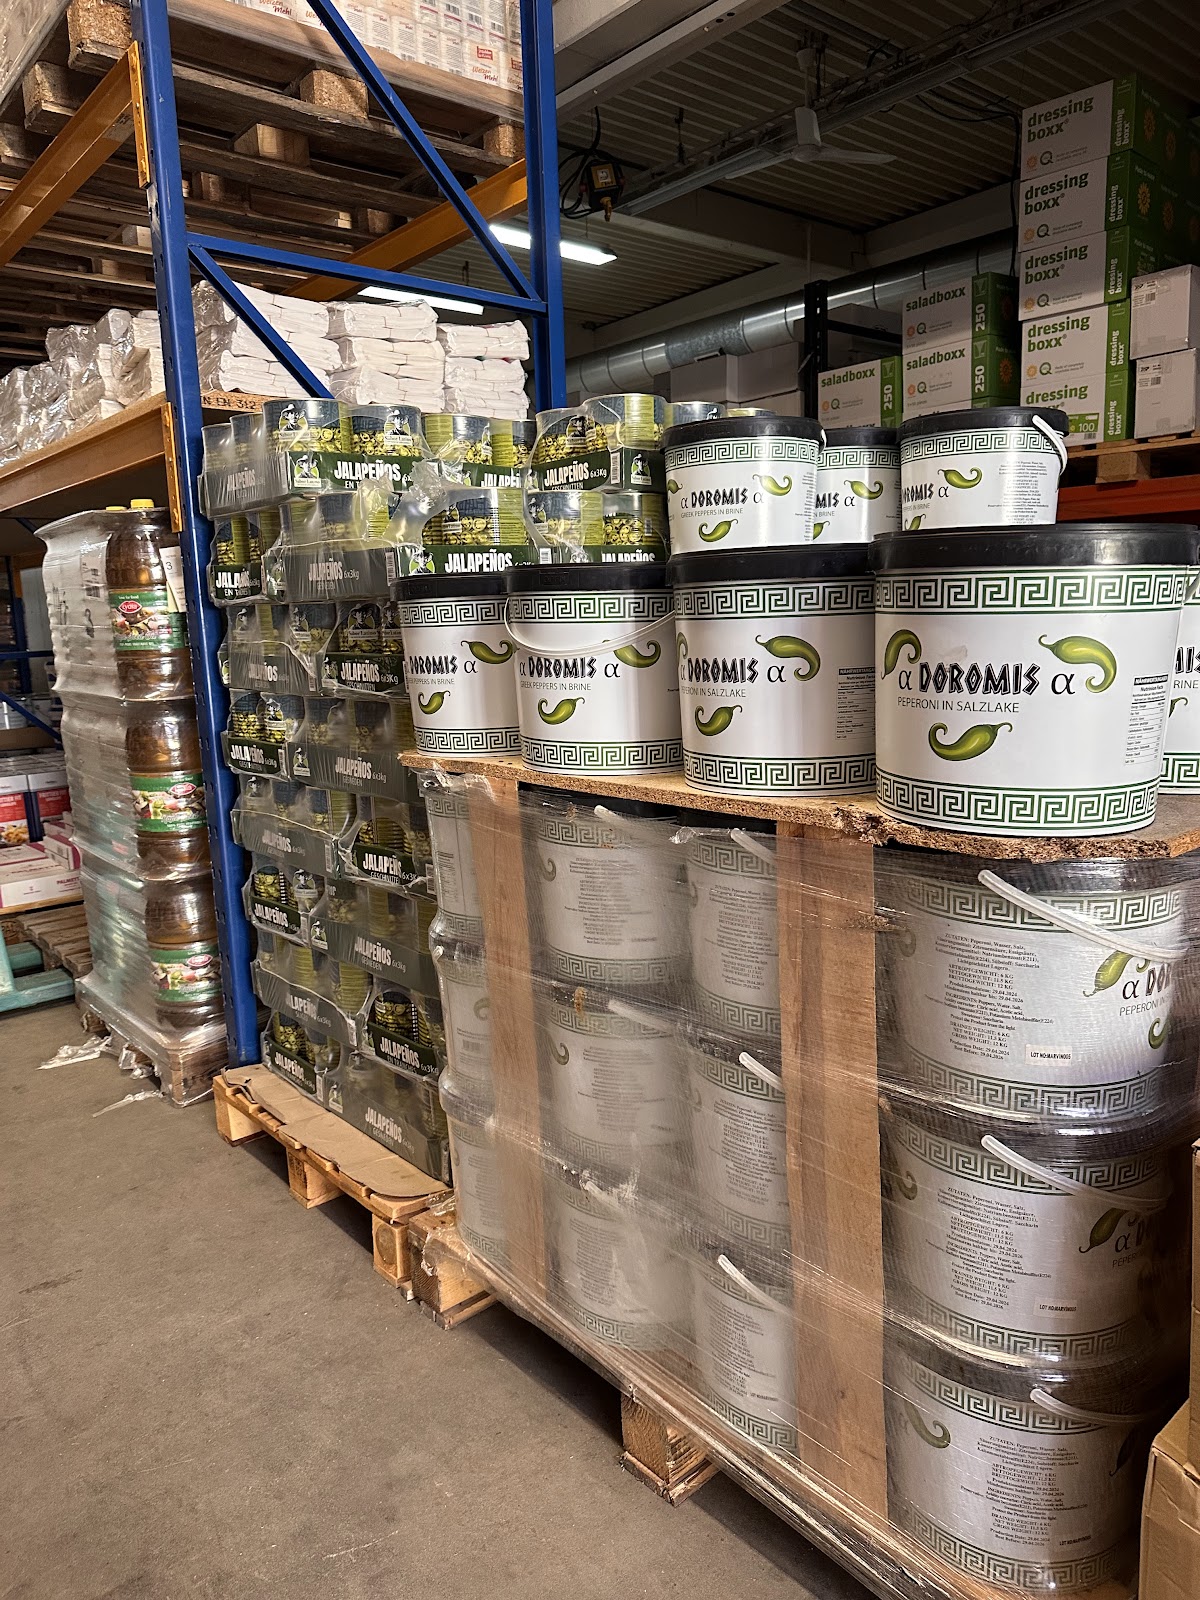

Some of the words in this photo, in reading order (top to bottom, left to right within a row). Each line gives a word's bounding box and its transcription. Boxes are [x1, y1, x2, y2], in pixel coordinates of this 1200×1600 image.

[273, 5, 292, 16] Mehl
[1028, 96, 1094, 127] dressing
[1115, 108, 1125, 146] dressing
[1025, 173, 1089, 200] dressing
[1109, 184, 1118, 222] dressing
[1025, 245, 1089, 270] dressing
[1108, 257, 1118, 295] dressing
[905, 286, 966, 312] saladboxx
[976, 303, 985, 332] 250
[1028, 316, 1090, 338] dressing
[906, 348, 966, 370] saladboxx
[1110, 330, 1119, 366] dressing
[821, 367, 876, 387] saladboxx
[975, 365, 985, 393] 250
[884, 384, 892, 410] 250
[1026, 385, 1088, 404] dressing
[1079, 423, 1094, 432] 100
[1108, 400, 1117, 436] dressing
[334, 460, 400, 482] JALAPEÑOS
[544, 461, 589, 487] JALAPEÑOS
[691, 488, 748, 508] DOROMIS
[681, 510, 694, 518] GREEK
[309, 558, 343, 581] JALAPEÑOS
[445, 550, 512, 573] JALAPEÑOS
[340, 660, 380, 682] JALAPEÑOS
[528, 656, 597, 678] DOROMIS
[688, 657, 759, 684] DOROMIS
[919, 662, 1041, 695] DOROMIS
[533, 682, 557, 690] PEPPERS
[700, 688, 706, 696] IN
[707, 688, 746, 697] SALZLAKE
[1174, 680, 1199, 689] RINE
[898, 697, 939, 710] PEPERONI
[942, 701, 952, 711] IN
[956, 701, 1020, 714] SALZLAKE
[336, 757, 372, 779] JALAPEÑOS
[262, 829, 292, 852] JALAPEÑOS
[363, 853, 402, 876] JALAPEÑOS
[254, 902, 288, 927] JALAPEÑOS
[354, 937, 391, 966] JALAPEÑOS
[380, 1036, 420, 1068] JALAPEÑOS
[274, 1051, 304, 1080] JALAPEÑOS
[365, 1107, 402, 1143] JALAPEÑOS
